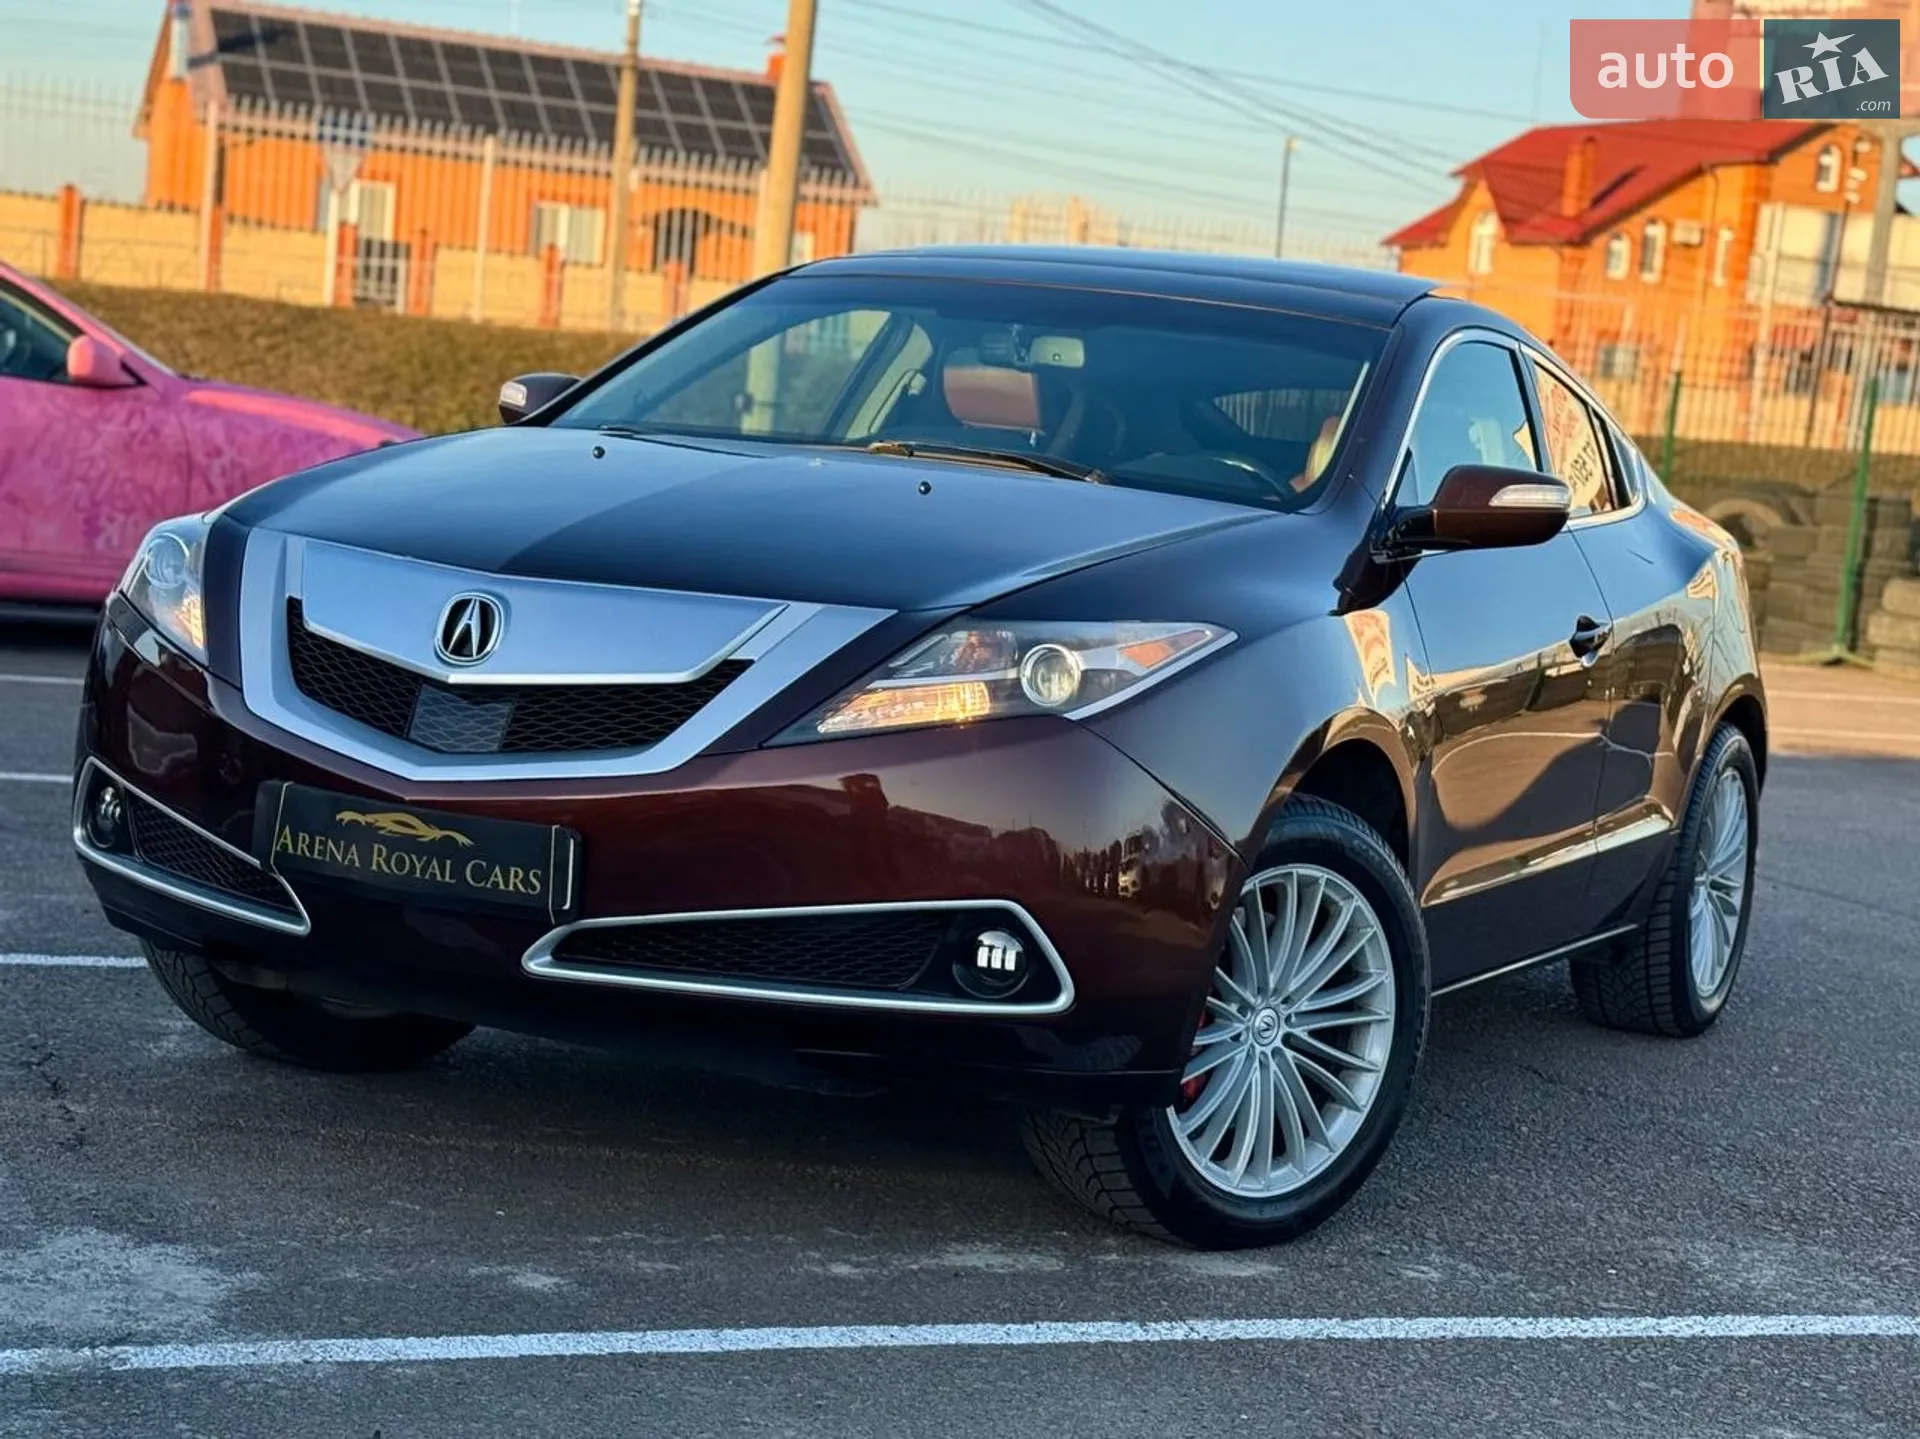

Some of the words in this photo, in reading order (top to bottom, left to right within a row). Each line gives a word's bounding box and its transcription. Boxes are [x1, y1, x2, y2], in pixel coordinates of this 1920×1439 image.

[276, 824, 361, 869] ARENA
[371, 844, 457, 884] ROYAL
[465, 859, 542, 895] CARS
